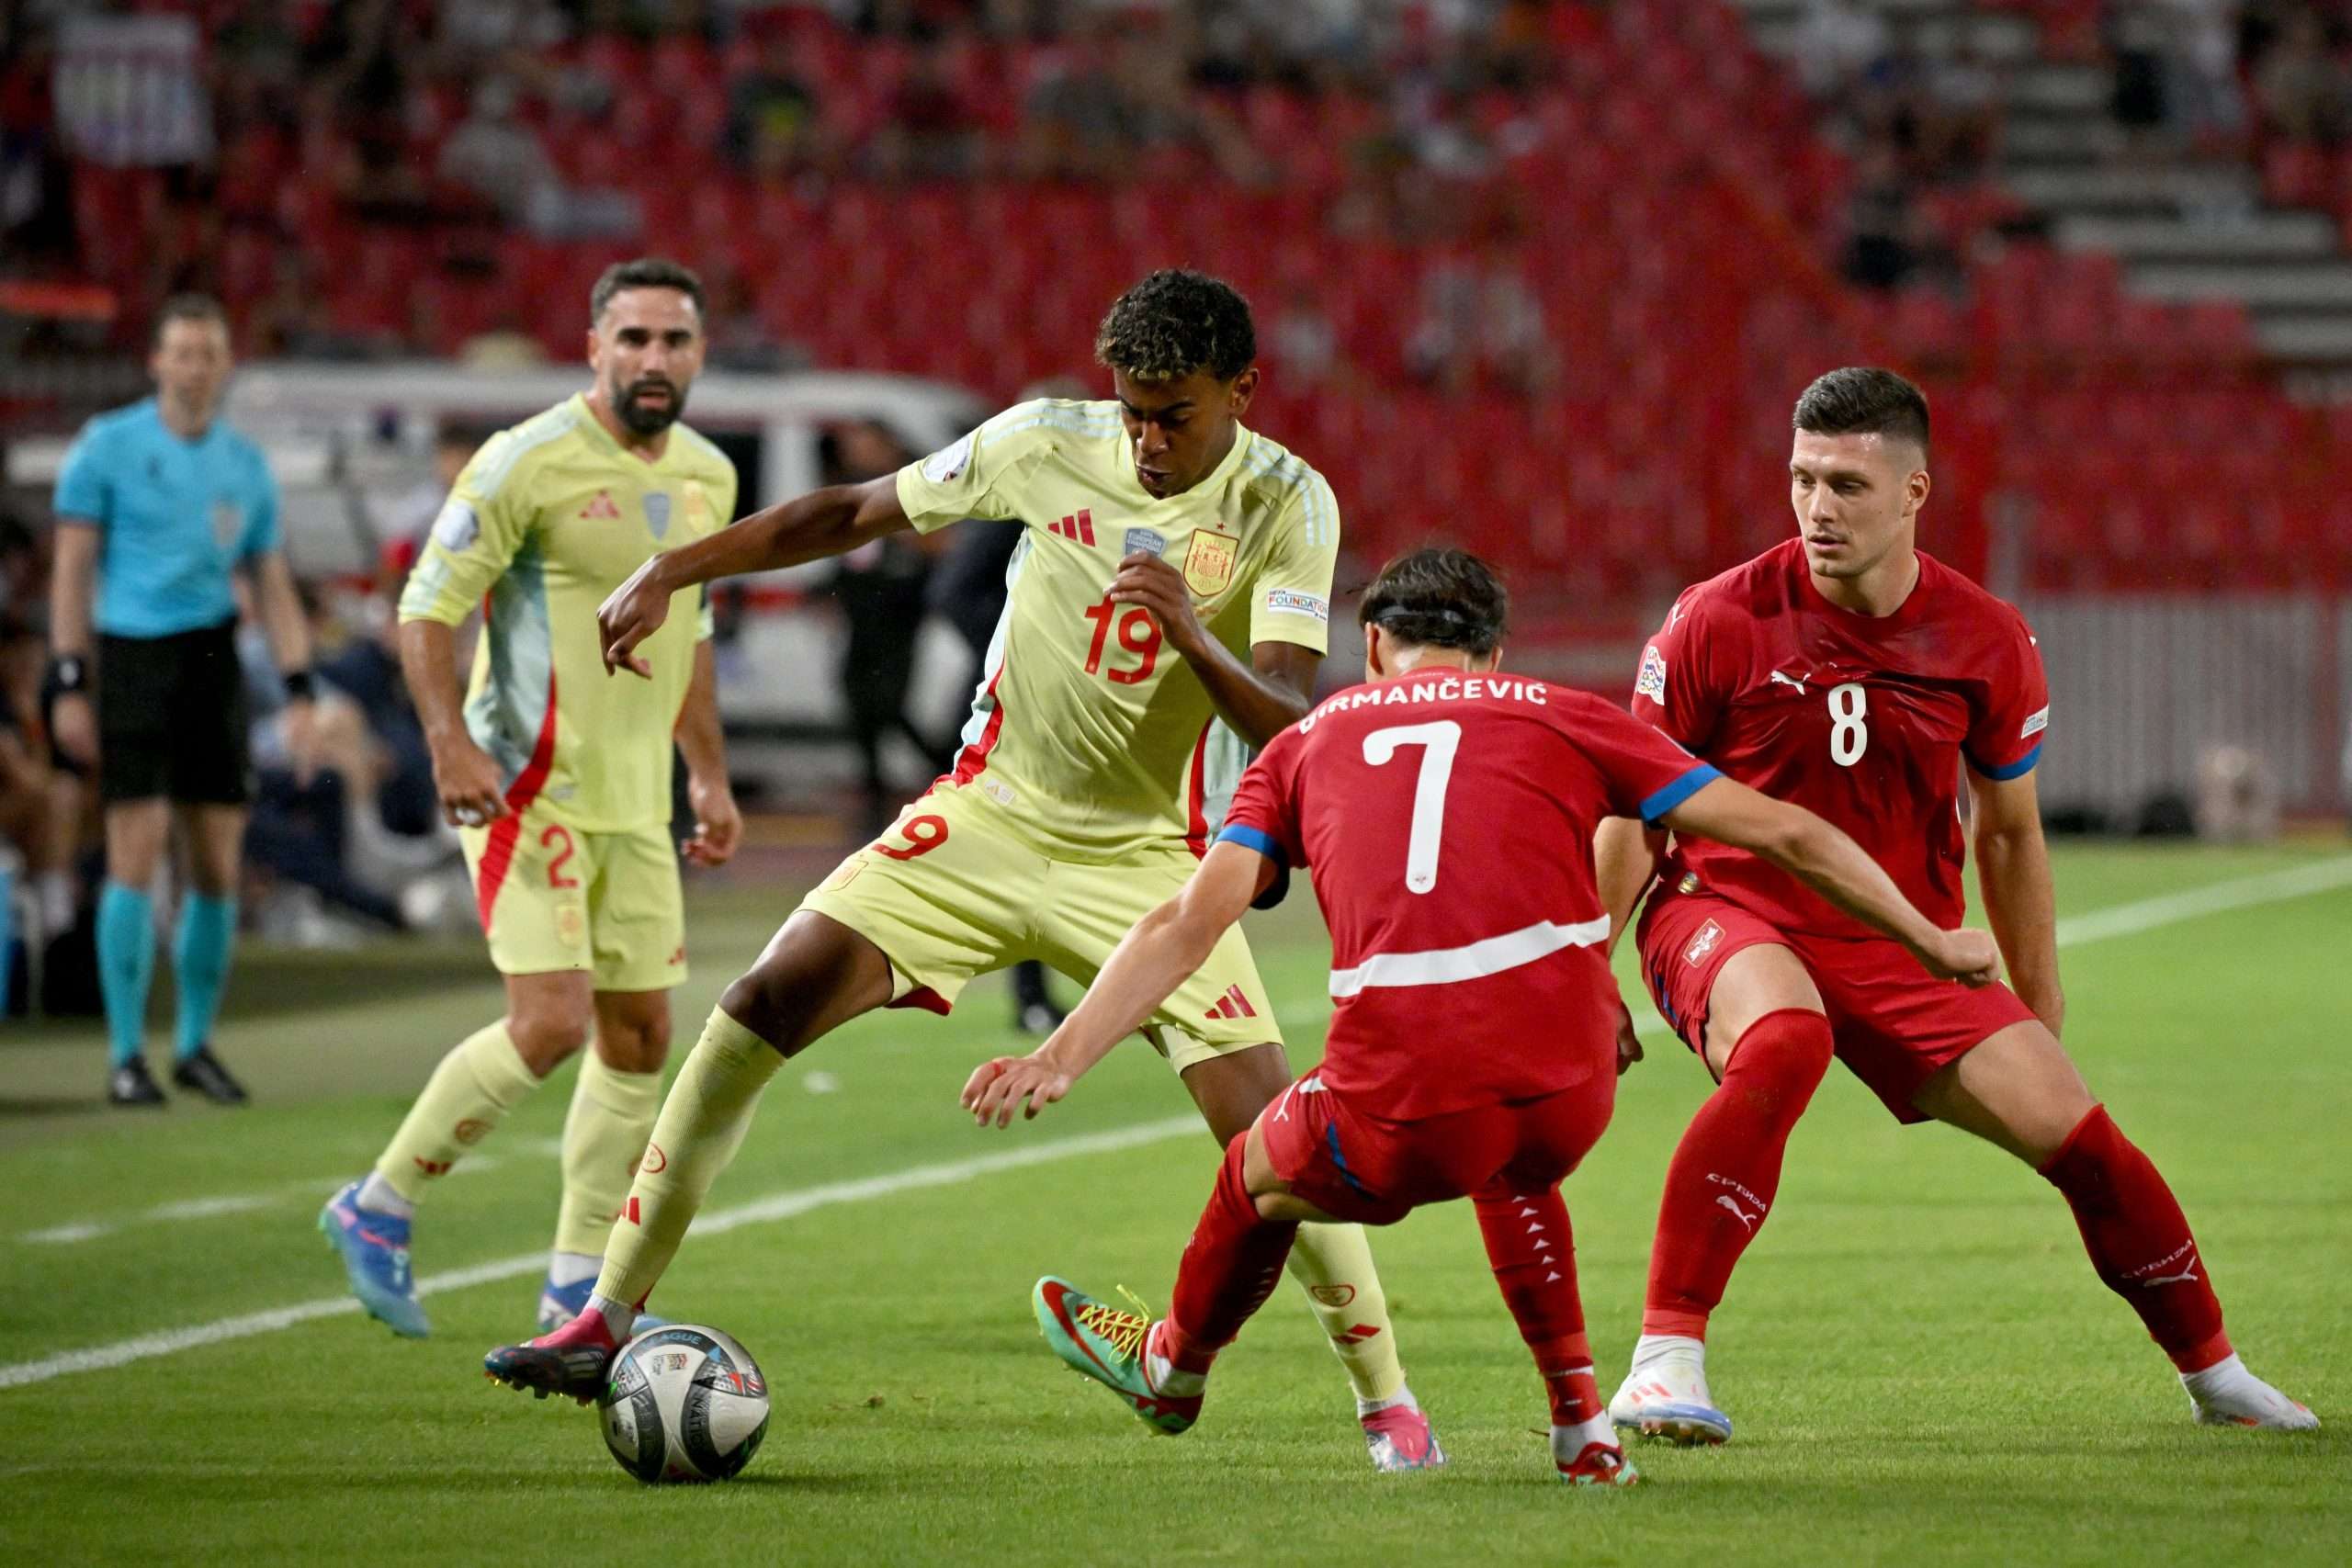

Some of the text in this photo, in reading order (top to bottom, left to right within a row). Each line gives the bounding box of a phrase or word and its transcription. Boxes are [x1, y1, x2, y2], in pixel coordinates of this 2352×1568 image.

[1084, 593, 1162, 684] 19
[1827, 682, 1868, 767] 8
[1363, 719, 1463, 895] 7
[539, 823, 578, 888] 2
